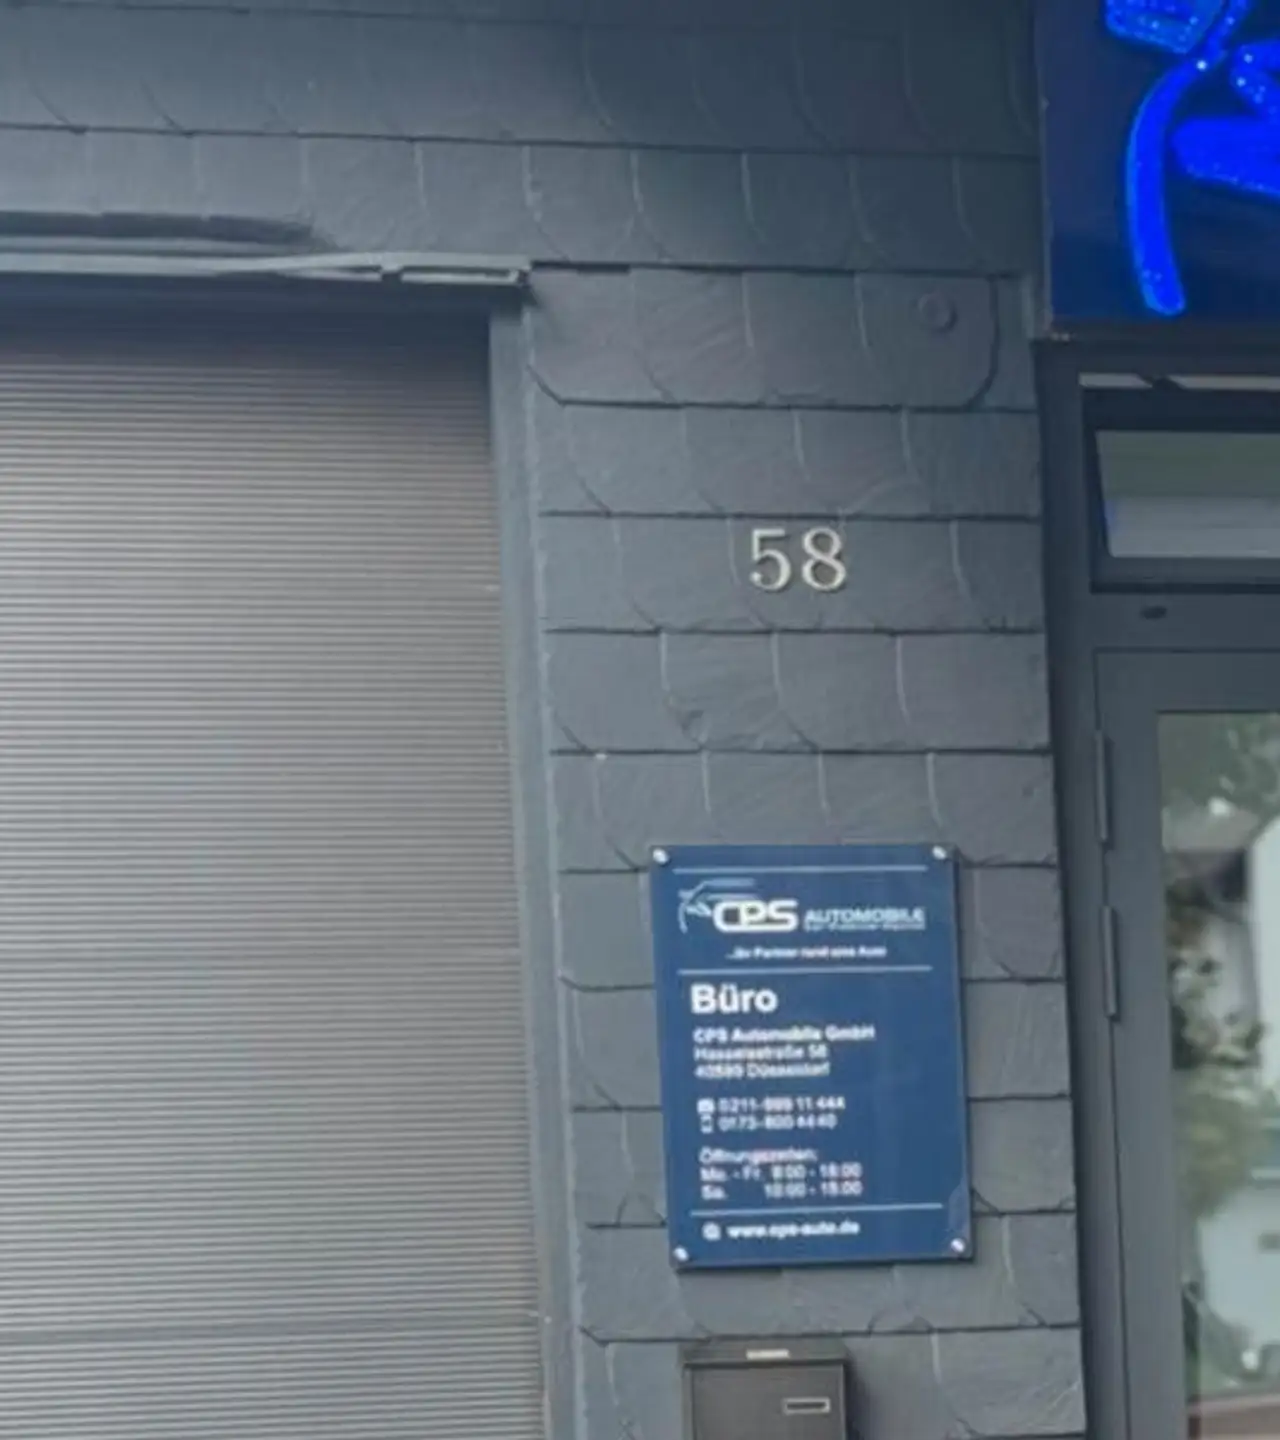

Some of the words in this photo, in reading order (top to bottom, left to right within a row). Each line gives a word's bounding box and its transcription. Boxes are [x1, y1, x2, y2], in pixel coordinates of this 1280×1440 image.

[750, 526, 846, 591] 58
[712, 899, 799, 933] CPS
[804, 907, 926, 924] AUTOMOBILE
[690, 982, 779, 1014] Büro
[692, 1027, 728, 1043] CPS
[731, 1025, 822, 1042] Automobile
[825, 1024, 876, 1042] GmbH
